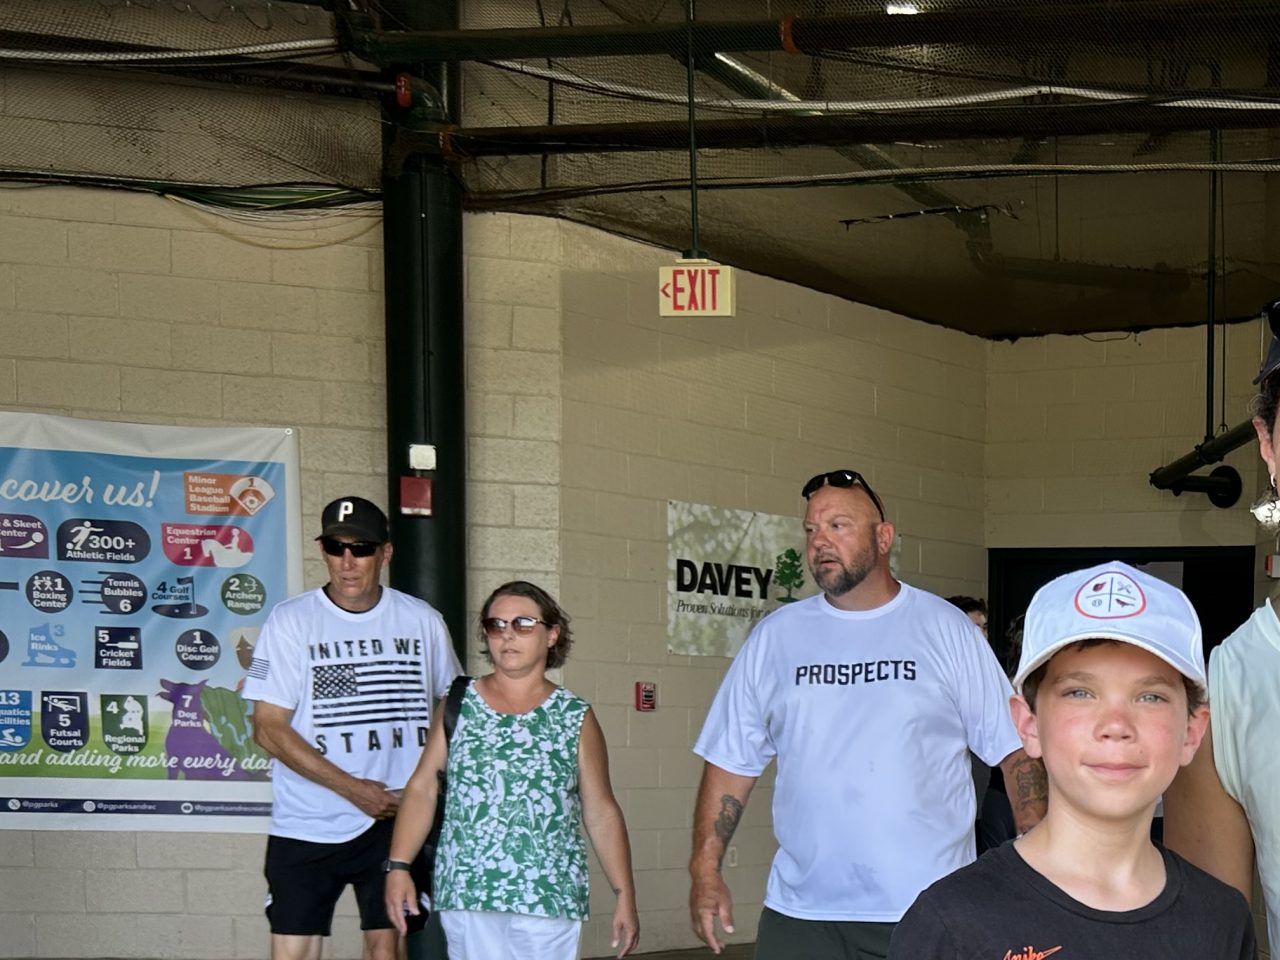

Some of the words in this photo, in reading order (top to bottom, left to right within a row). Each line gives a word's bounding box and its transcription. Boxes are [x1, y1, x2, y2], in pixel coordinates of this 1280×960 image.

[673, 269, 720, 311] EXIT
[188, 476, 216, 484] Minor
[103, 470, 160, 508] us!
[189, 485, 224, 494] League
[189, 494, 231, 503] Baseball
[190, 503, 229, 512] Stadium
[338, 501, 354, 522] P
[13, 519, 43, 528] Skeet
[0, 529, 28, 538] enter
[166, 526, 217, 537] Equestrian
[88, 535, 136, 549] 300+
[167, 536, 200, 544] Center
[66, 550, 105, 560] Athletic
[106, 552, 136, 561] Fields
[184, 547, 193, 559] 1
[107, 579, 140, 587] Tennis
[229, 578, 240, 590] 2
[676, 559, 773, 599] DAVEY
[54, 578, 65, 591] 1
[157, 582, 167, 593] 4
[169, 585, 189, 594] Golf
[33, 591, 67, 601] Boxing
[104, 588, 143, 597] Bubbles
[152, 593, 190, 601] Courses
[225, 591, 263, 602] Archery
[33, 600, 66, 608] Center
[120, 600, 132, 612] 6
[227, 600, 261, 609] Ranges
[677, 600, 708, 614] Proven
[710, 603, 748, 618] Solutions
[54, 624, 65, 637] 3
[31, 633, 46, 641] Ice
[98, 630, 109, 642] 5
[193, 631, 203, 644] 1
[31, 642, 59, 651] Rinks
[177, 644, 198, 653] Disc
[199, 645, 219, 653] Golf
[394, 637, 421, 656] WE
[100, 649, 135, 658] Cricket
[181, 653, 215, 661] Course
[102, 658, 132, 667] Fields
[796, 660, 917, 686] PROSPECTS
[182, 695, 193, 707] 7
[106, 702, 119, 714] 4
[178, 710, 198, 719] Dog
[59, 714, 71, 727] 5
[174, 719, 201, 727] Parks
[50, 728, 81, 737] Futsal
[49, 737, 83, 746] Courts
[105, 735, 146, 745] Regional
[315, 727, 428, 755] STAND
[112, 743, 139, 752] Parks
[0, 749, 43, 765] and
[46, 749, 122, 773] adding
[127, 753, 178, 768] more
[183, 754, 237, 776] every
